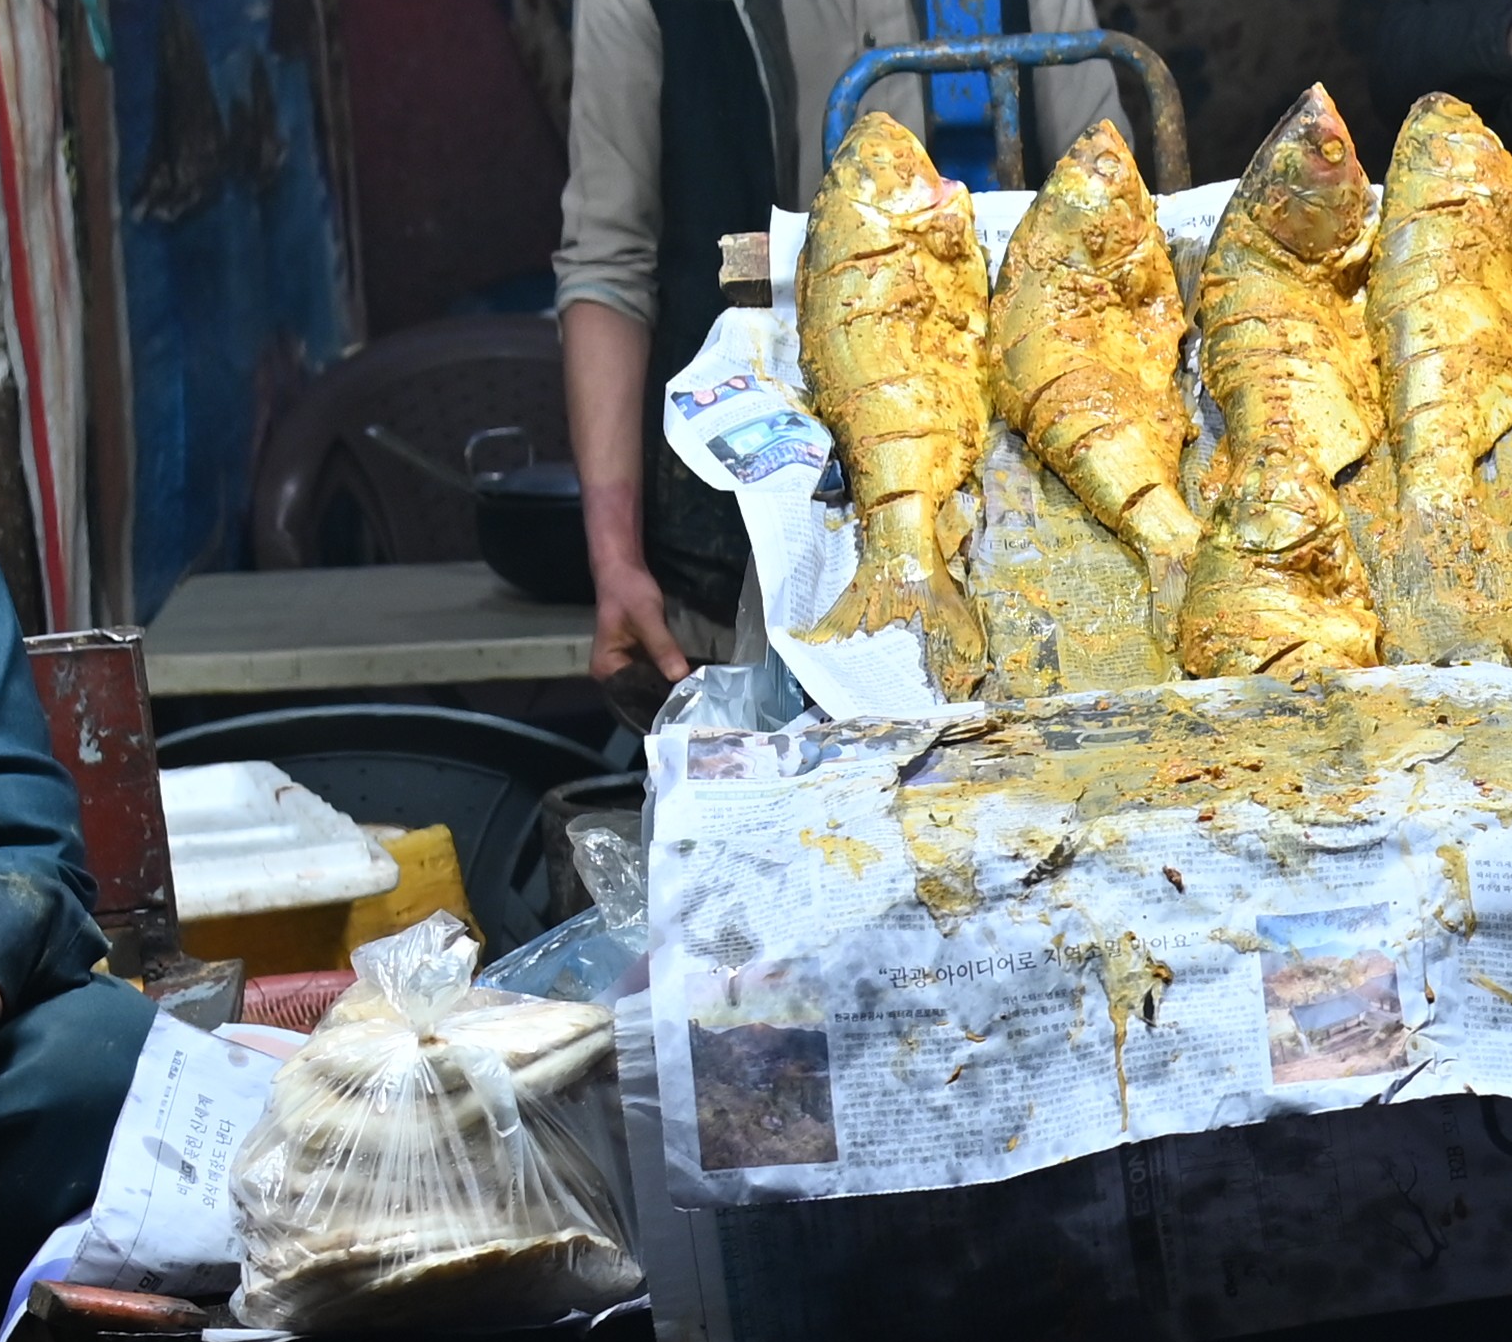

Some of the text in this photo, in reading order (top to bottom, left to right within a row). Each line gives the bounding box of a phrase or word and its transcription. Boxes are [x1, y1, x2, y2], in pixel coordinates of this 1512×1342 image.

[935, 951, 1038, 987] 아이디어로
[190, 1093, 213, 1135] 신세계
[200, 1182, 219, 1210] 외식
[215, 1117, 235, 1146] 낸다
[1446, 1145, 1467, 1180] B2B
